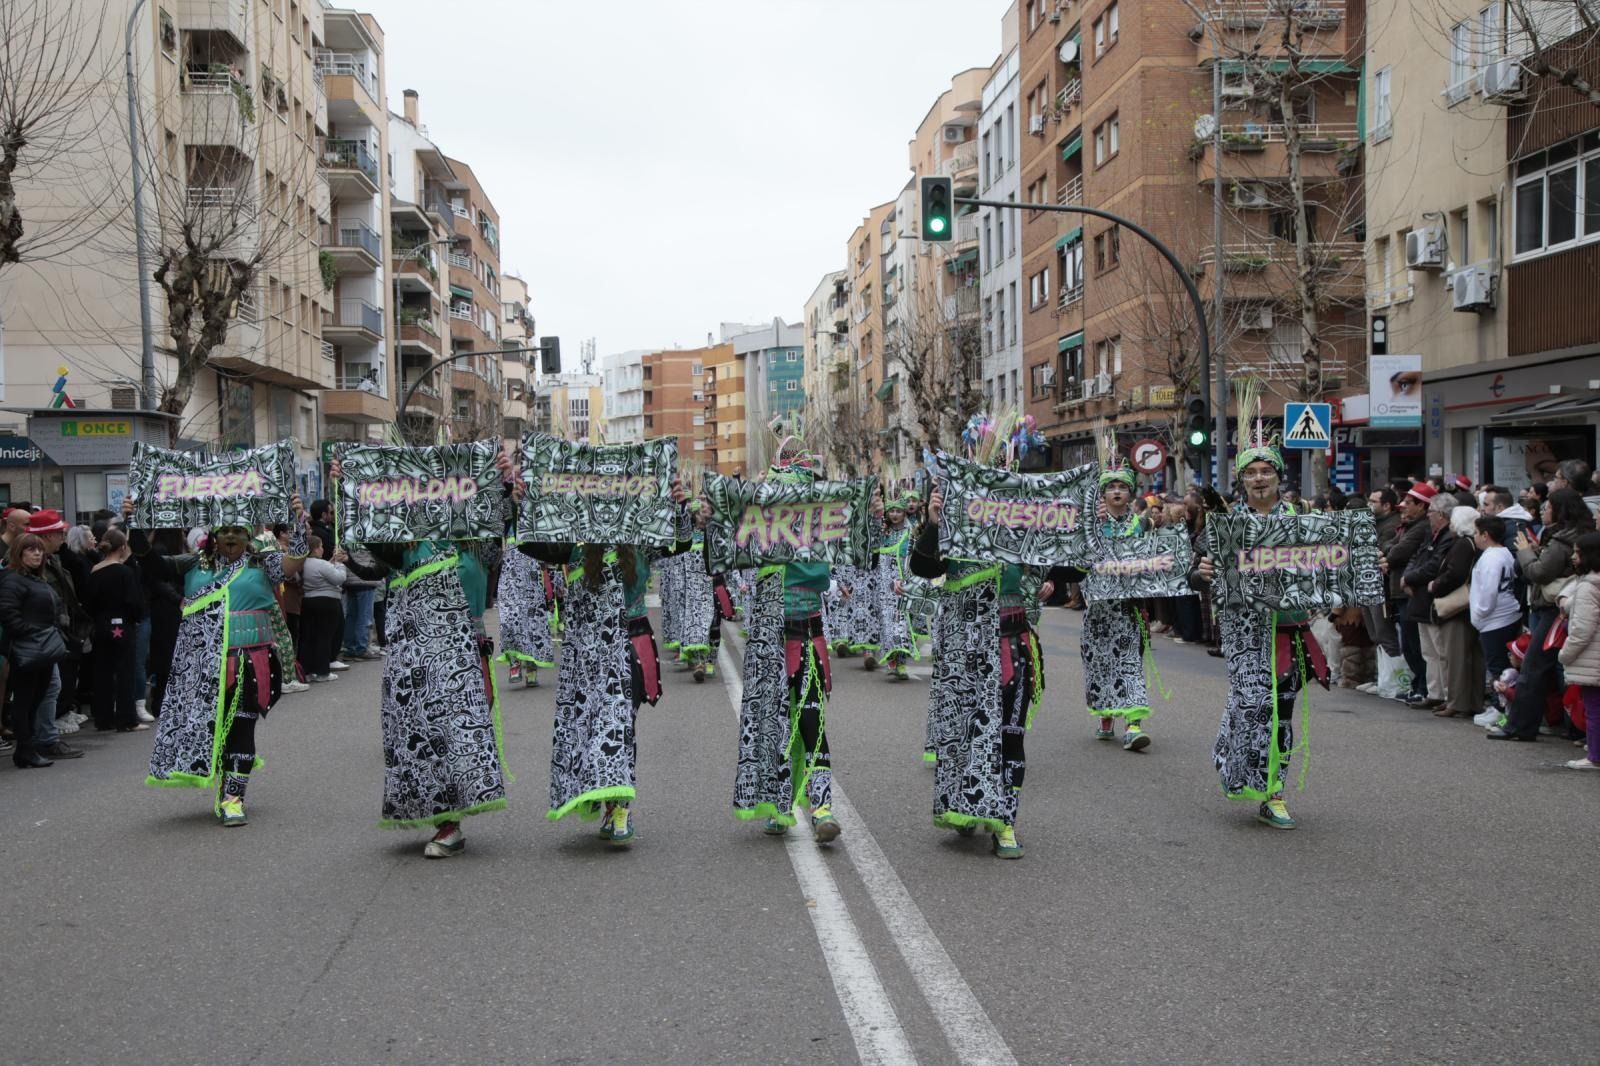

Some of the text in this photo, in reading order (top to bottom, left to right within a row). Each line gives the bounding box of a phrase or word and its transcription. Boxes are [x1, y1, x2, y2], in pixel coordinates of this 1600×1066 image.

[83, 423, 126, 434] ONCE
[158, 468, 263, 501] FUERZA
[359, 476, 478, 505] IGUALDAD
[541, 473, 658, 497] DERECHOS
[736, 501, 849, 550] ARTE
[1236, 545, 1348, 573] LIBERTAD
